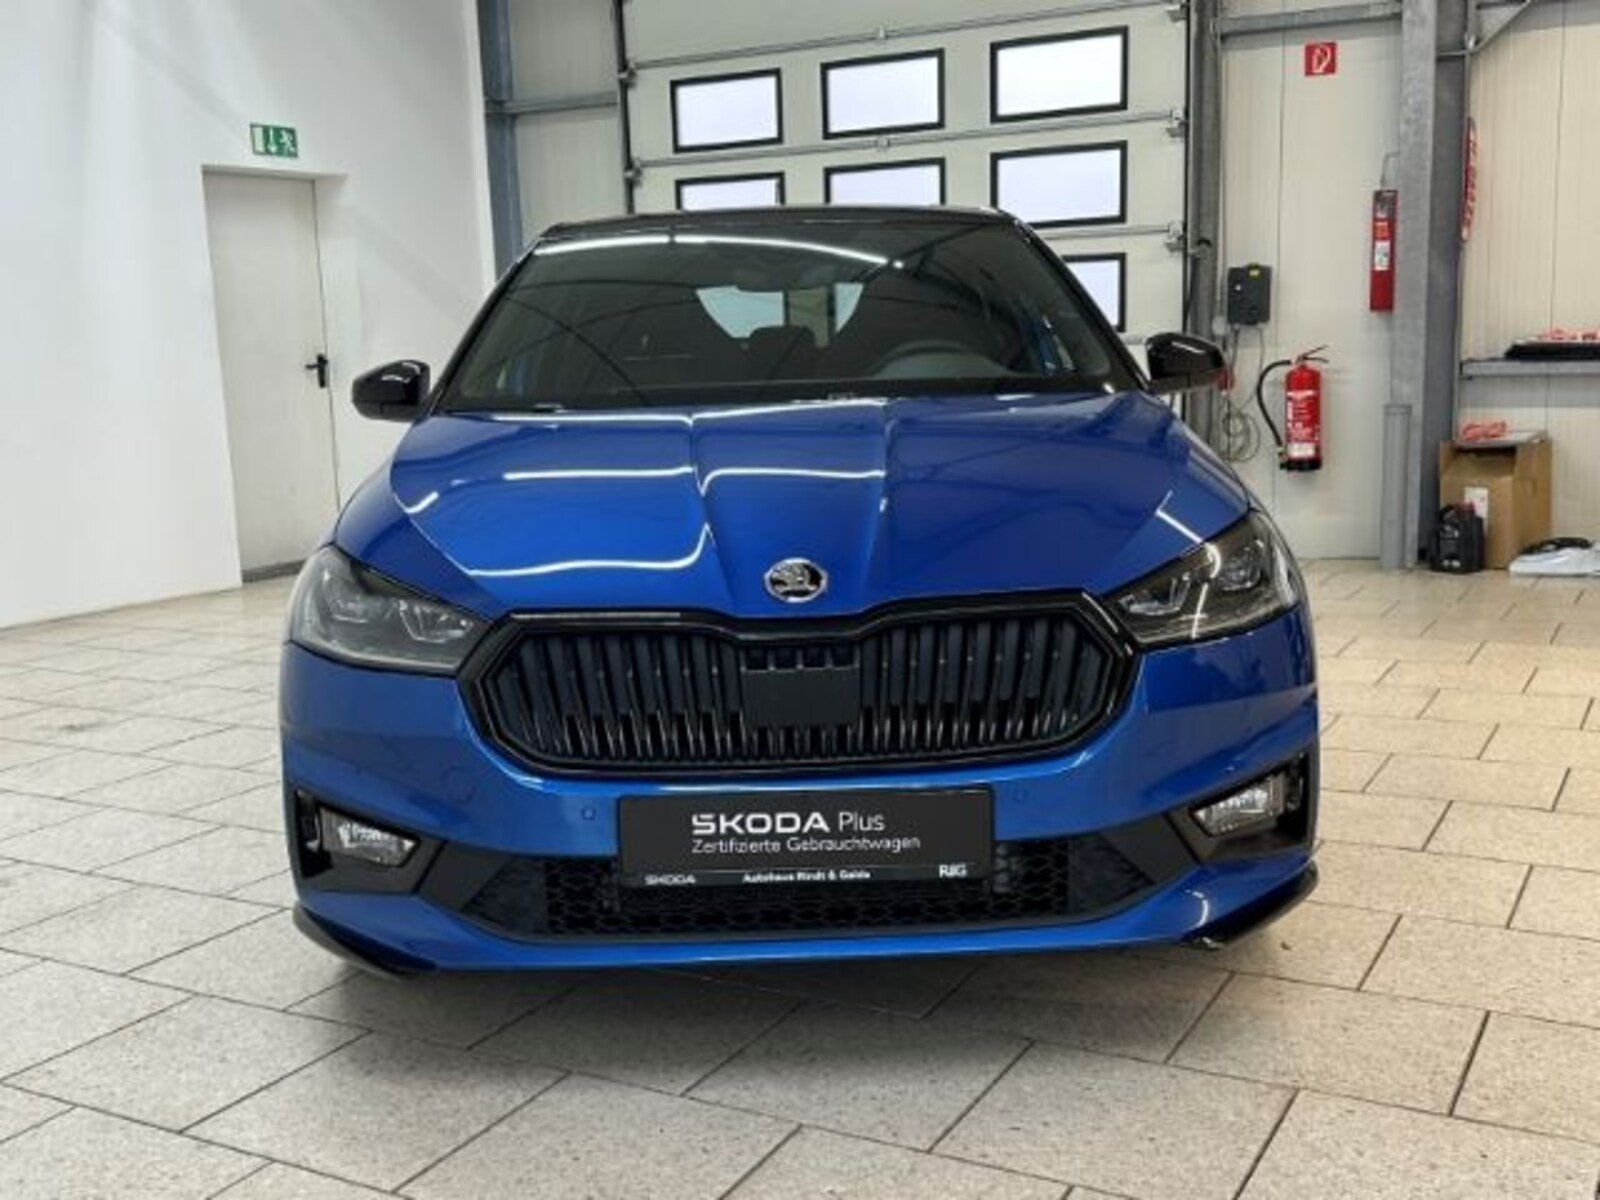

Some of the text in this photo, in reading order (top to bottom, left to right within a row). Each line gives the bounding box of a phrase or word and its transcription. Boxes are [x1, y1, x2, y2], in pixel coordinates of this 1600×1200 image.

[691, 811, 886, 835] SKODA Plus
[691, 836, 921, 854] Zertifizierte Gebrauchtwagen
